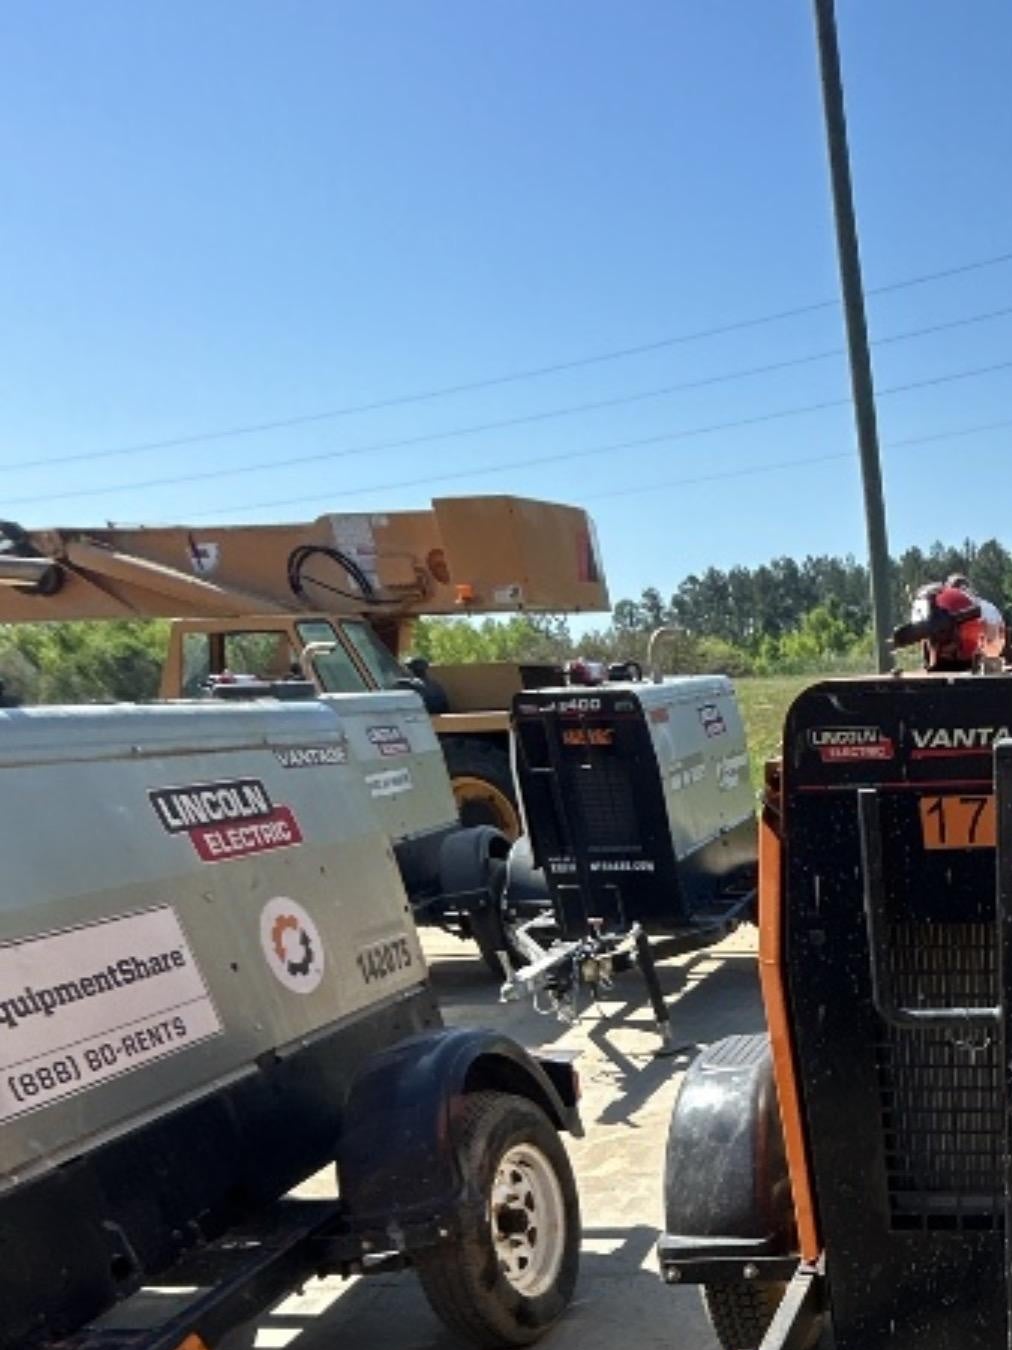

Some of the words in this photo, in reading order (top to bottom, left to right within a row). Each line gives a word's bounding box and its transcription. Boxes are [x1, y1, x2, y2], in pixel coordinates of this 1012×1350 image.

[157, 784, 270, 827] LINCOLN
[203, 820, 293, 855] ELECTRIC
[8, 1055, 82, 1102] (888)
